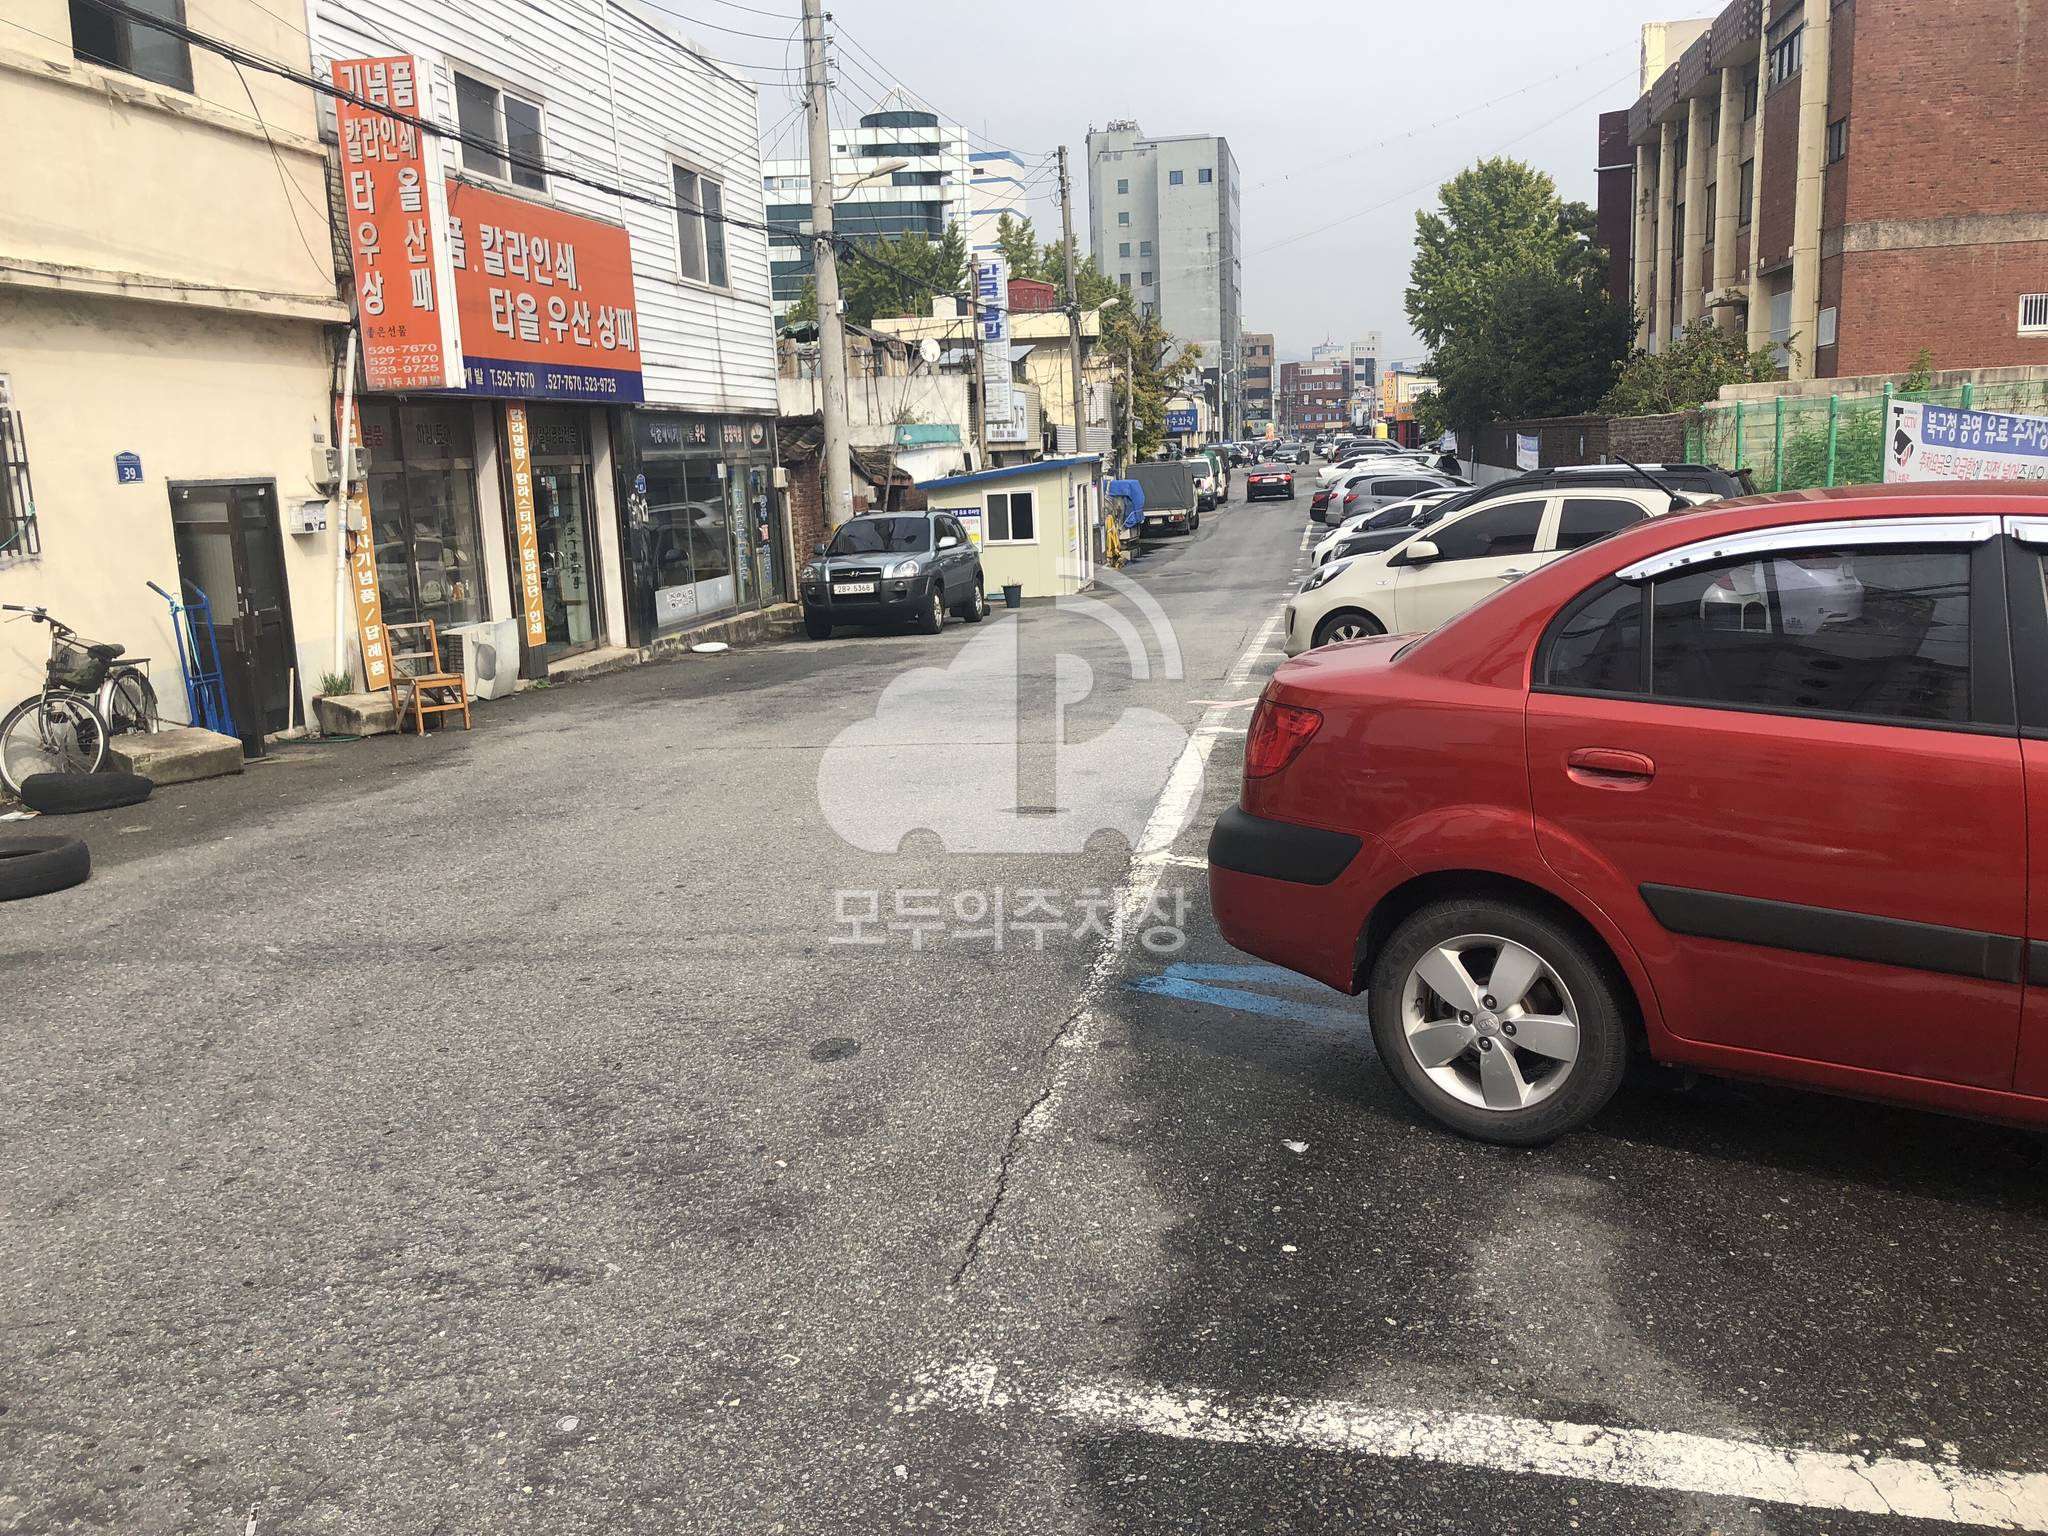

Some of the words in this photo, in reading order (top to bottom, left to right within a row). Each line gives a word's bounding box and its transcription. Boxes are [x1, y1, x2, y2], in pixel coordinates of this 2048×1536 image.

[339, 61, 415, 109] 기념품
[344, 116, 418, 164] 칼라인쇄
[368, 343, 437, 355] 526-7670
[370, 354, 438, 366] 527-7670
[370, 364, 439, 375] 523-9725
[1927, 411, 1958, 442] 북구청
[1960, 414, 1983, 444] 공영
[1985, 416, 2008, 445] 유료
[124, 467, 137, 480] 39
